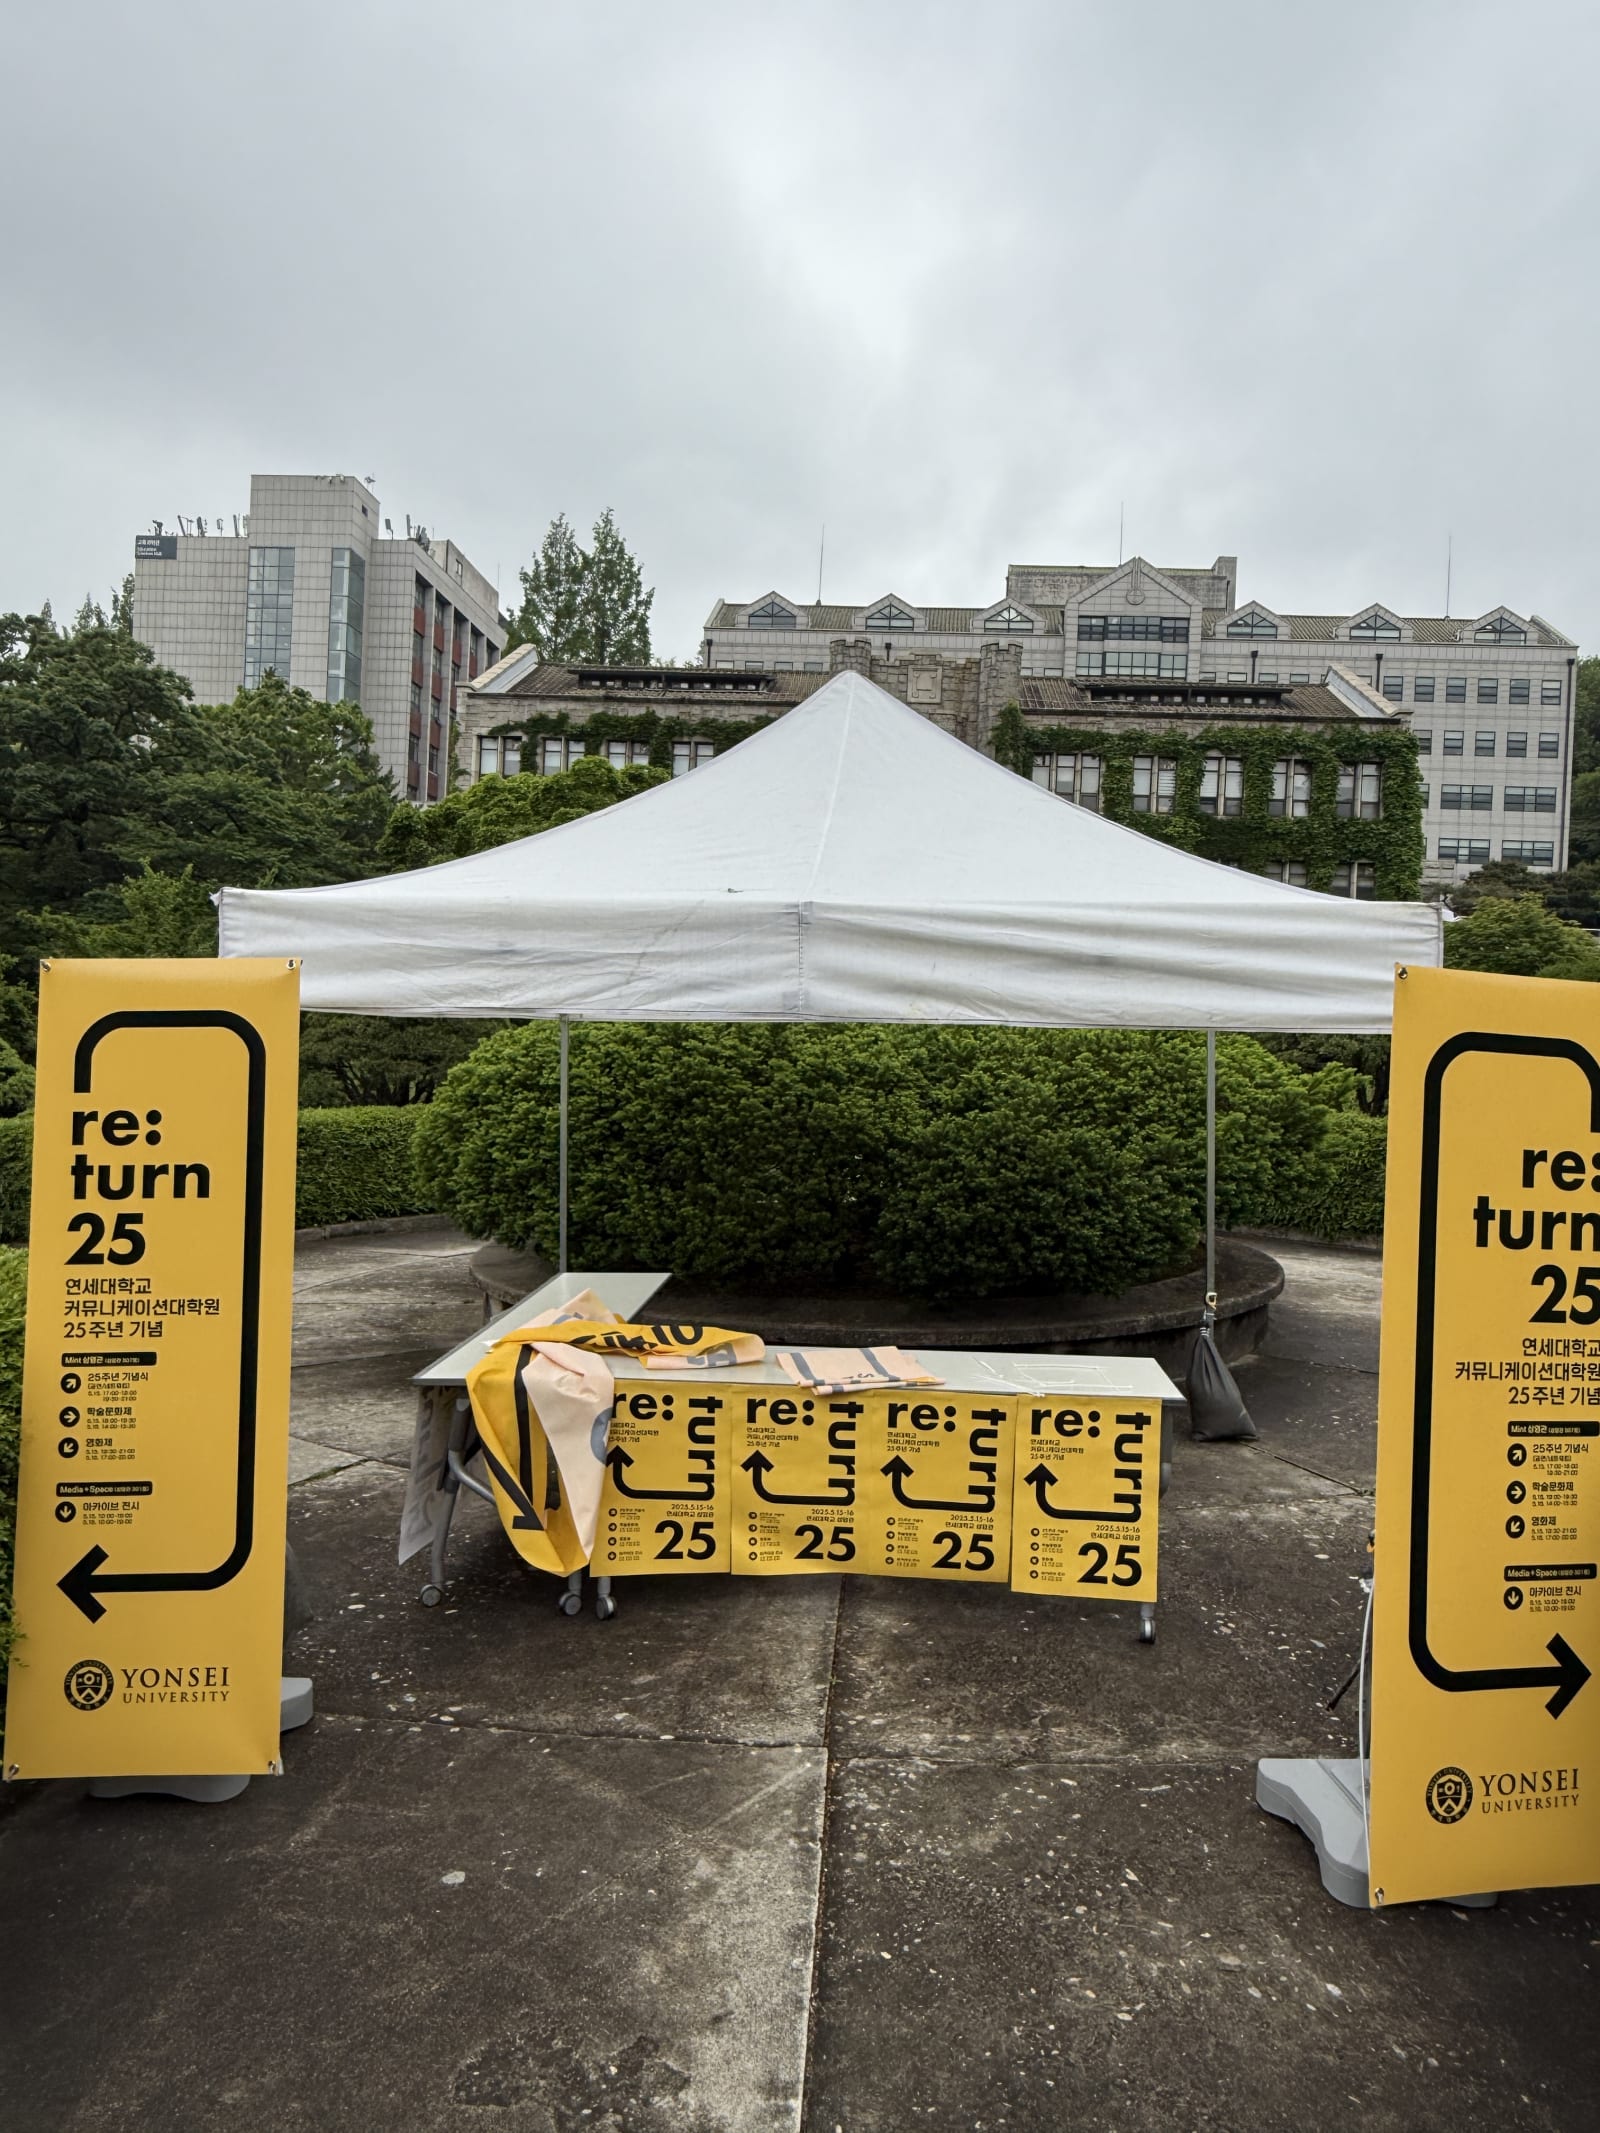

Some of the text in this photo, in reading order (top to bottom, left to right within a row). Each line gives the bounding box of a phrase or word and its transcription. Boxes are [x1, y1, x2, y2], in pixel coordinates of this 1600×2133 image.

[72, 1109, 162, 1146] re:
[71, 1154, 210, 1200] turn
[1473, 1195, 1600, 1252] turn
[64, 1212, 146, 1266] 25
[65, 1278, 152, 1295] 연세대학교
[1529, 1264, 1600, 1325] 25
[64, 1299, 220, 1317] 커뮤니케이션대학원
[63, 1321, 163, 1339] 25주년 기념
[1522, 1337, 1600, 1358] 연세대학교
[88, 1371, 149, 1382] 25주년 기념식
[1455, 1361, 1600, 1382] 커뮤니케이션대학원
[1508, 1386, 1600, 1406] 25주년 기념
[746, 1398, 815, 1426] re:
[887, 1403, 957, 1432] re:
[1031, 1409, 1101, 1438] re:
[688, 1396, 723, 1500] turn
[828, 1401, 864, 1505] turn
[968, 1408, 1007, 1512] turn
[1532, 1443, 1589, 1453] 25주년 기념식
[1114, 1412, 1151, 1521] turn
[950, 1514, 994, 1523] 2025.5.15-16
[1095, 1525, 1141, 1533] 2025.5.15-16
[653, 1519, 717, 1560] 25
[793, 1524, 856, 1562] 25
[931, 1530, 995, 1571] 25
[1077, 1541, 1142, 1587] 25
[121, 1667, 230, 1689] YONSEI
[123, 1690, 230, 1704] UNIVERSITY
[1480, 1768, 1579, 1797] YONSEI
[1482, 1794, 1580, 1814] UNIVERSITY
